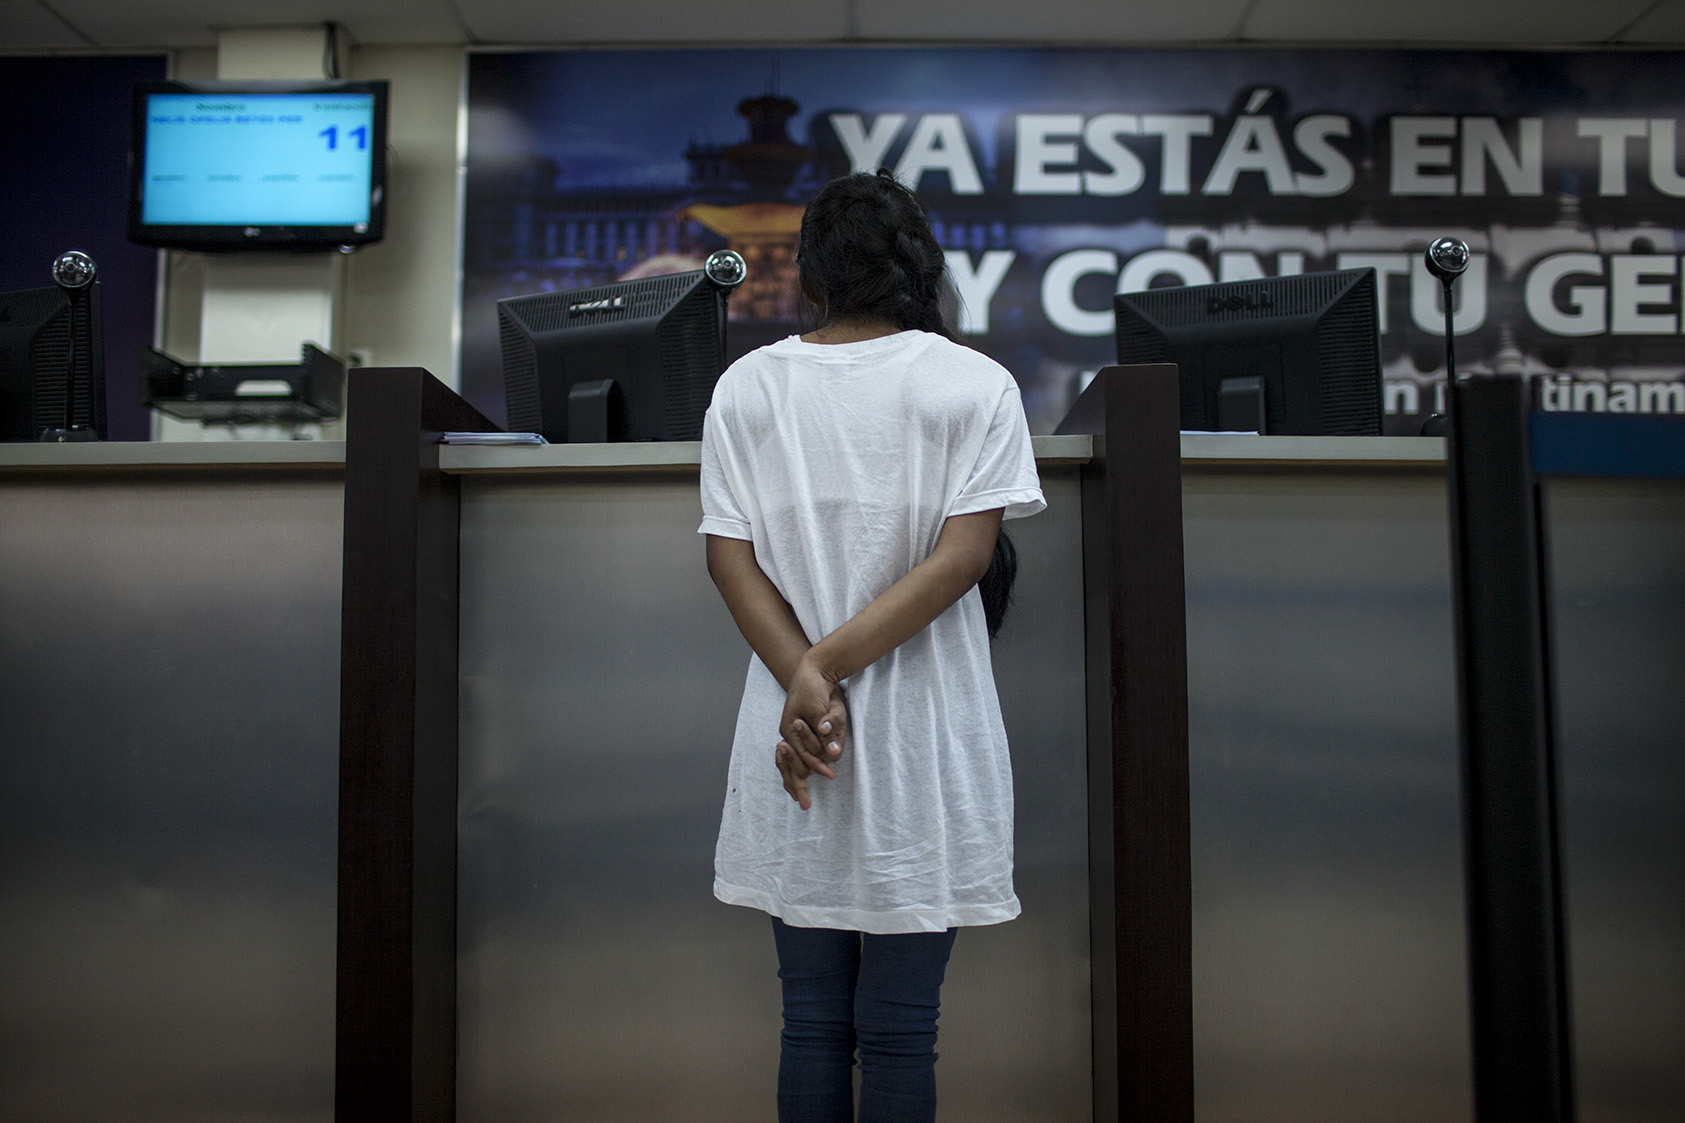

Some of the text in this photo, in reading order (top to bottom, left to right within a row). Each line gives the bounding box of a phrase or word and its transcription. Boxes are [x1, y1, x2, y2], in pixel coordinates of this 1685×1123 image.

[318, 124, 368, 151] 11
[829, 113, 985, 195] YA
[1013, 89, 1356, 196] ESTÁS
[1390, 116, 1544, 196] EN
[1524, 252, 1685, 337] GE
